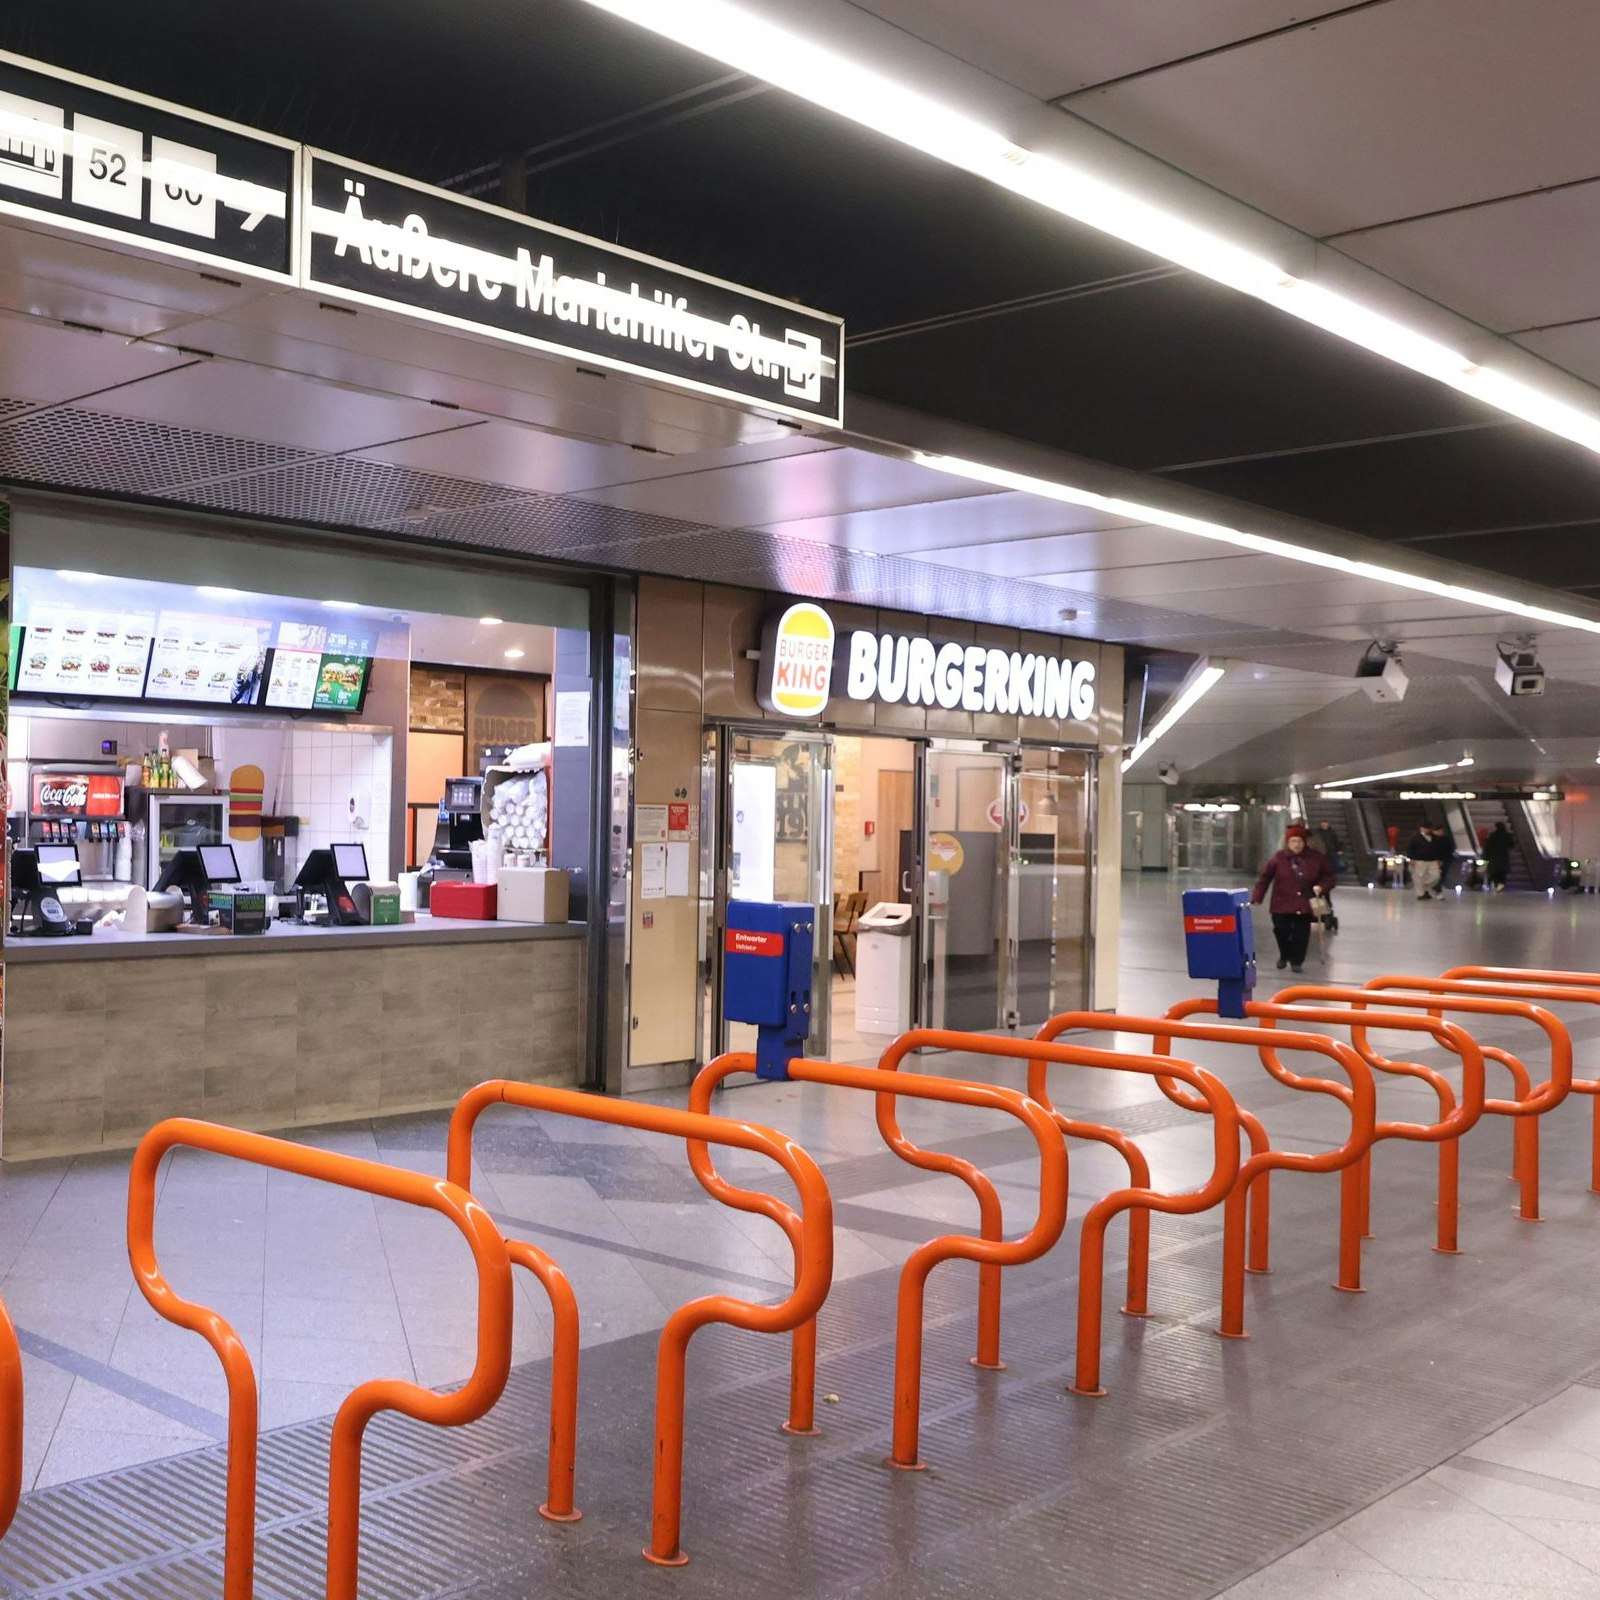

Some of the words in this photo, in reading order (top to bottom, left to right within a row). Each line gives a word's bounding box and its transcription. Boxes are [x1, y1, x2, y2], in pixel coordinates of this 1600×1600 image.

[89, 148, 127, 186] 52
[334, 178, 502, 300] Äußere
[516, 247, 714, 361] Mariahilfer
[780, 639, 829, 661] BURGER
[777, 665, 826, 691] KING
